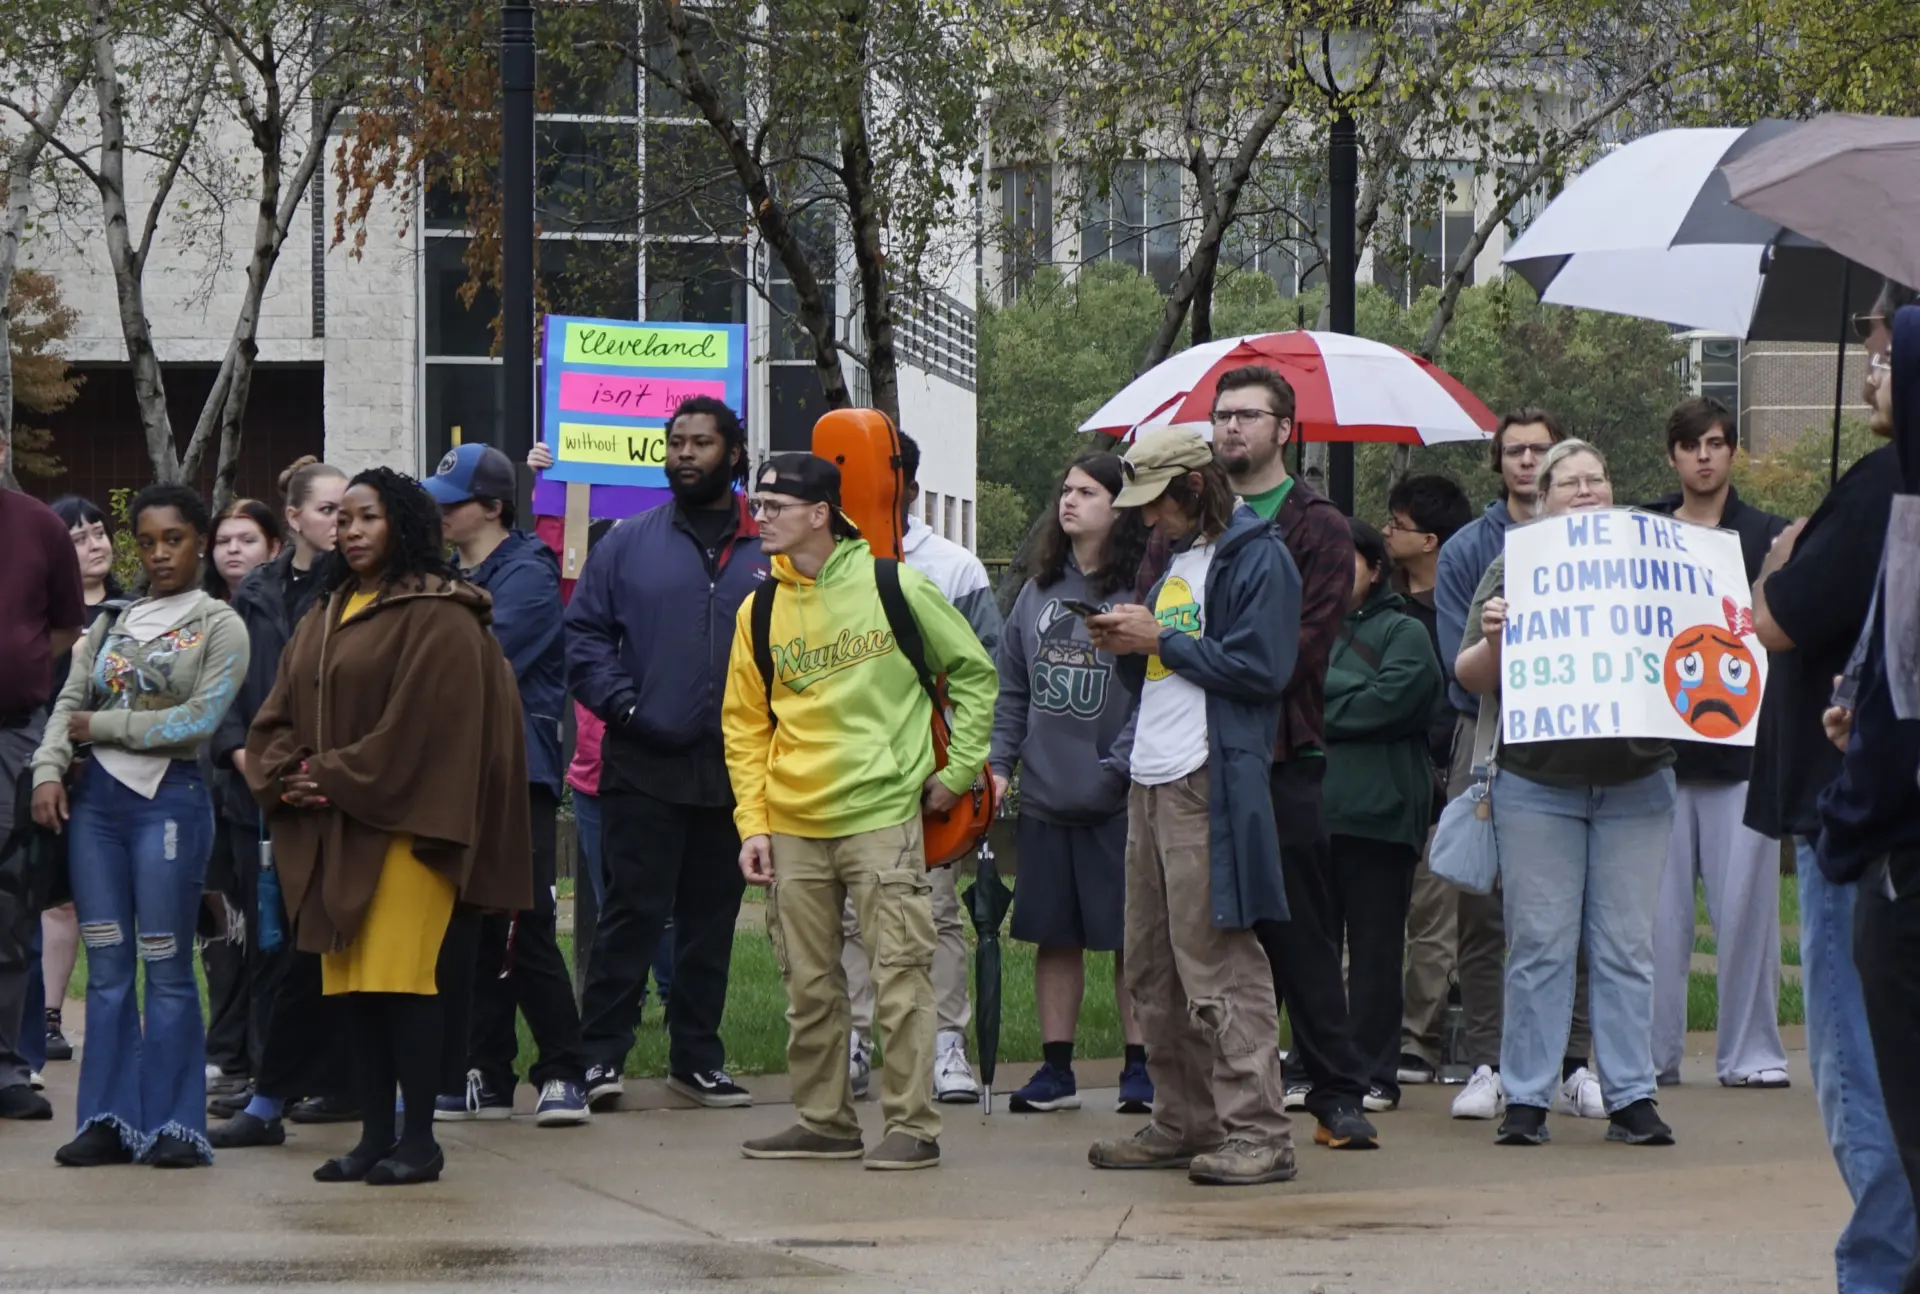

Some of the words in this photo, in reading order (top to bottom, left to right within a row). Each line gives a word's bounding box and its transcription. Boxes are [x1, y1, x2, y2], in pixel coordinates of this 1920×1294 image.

[579, 329, 716, 358] Cleveland
[592, 382, 652, 408] isn't
[565, 432, 619, 453] without
[627, 436, 667, 463] WC
[1567, 514, 1612, 547] WE
[1631, 515, 1688, 552] THE
[1533, 558, 1716, 596] COMMUNITY
[1505, 605, 1595, 646] WANT
[1609, 605, 1674, 639] OUR
[771, 628, 895, 681] Waylon
[1508, 653, 1576, 690] 89.3
[1592, 646, 1661, 684] DJ'S
[1031, 661, 1107, 715] CSU
